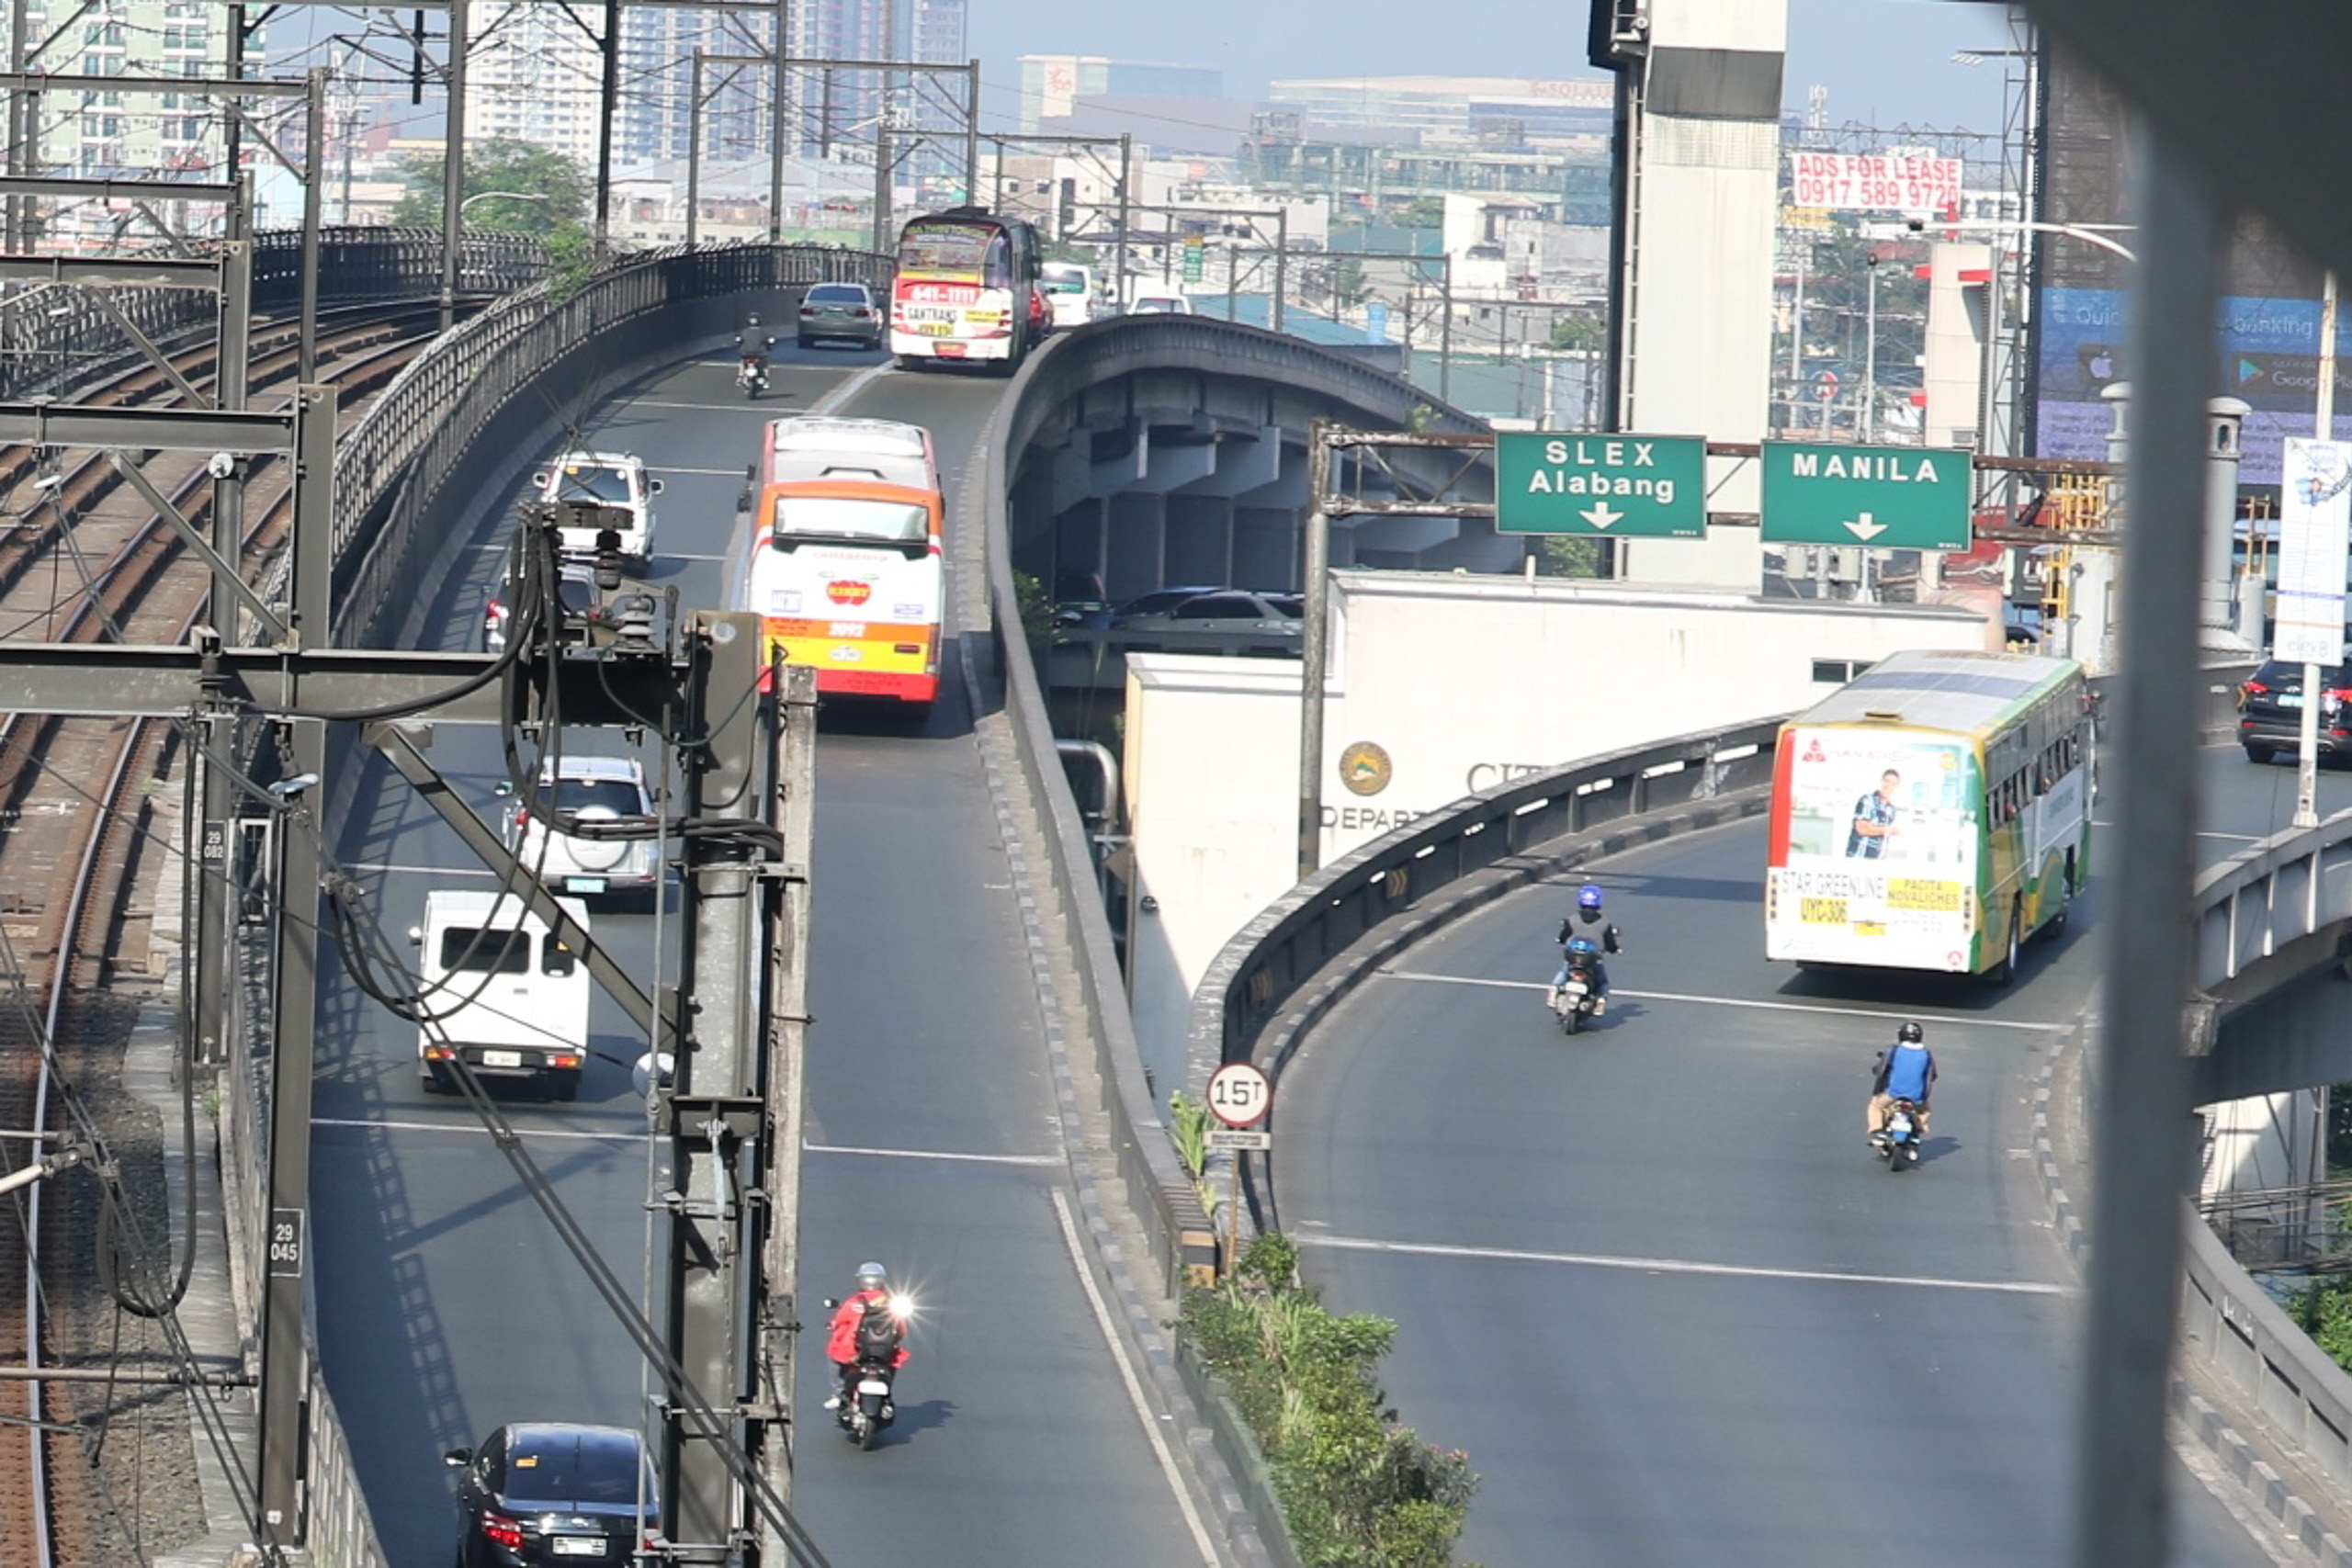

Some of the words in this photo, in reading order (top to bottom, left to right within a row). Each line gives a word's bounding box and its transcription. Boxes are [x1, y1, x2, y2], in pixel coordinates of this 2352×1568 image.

[1798, 154, 1838, 176] ADS
[1846, 158, 1886, 178] FOR
[1894, 159, 1958, 182] LEASE
[1800, 179, 1850, 203] 0917
[1861, 181, 1900, 205] 589
[1908, 184, 1958, 209] 9720
[2272, 370, 2316, 389] Goog
[1544, 440, 1655, 467] SLEX
[1792, 453, 1939, 482] MANILA
[1528, 469, 1675, 503] Alabang
[1321, 806, 1430, 830] DEPAR
[208, 830, 221, 844] 29
[1782, 872, 1812, 893] STAR
[1816, 873, 1883, 899] GREENLINE
[1905, 879, 1943, 891] PACITA
[1888, 890, 1960, 906] NOVALICHES
[275, 1223, 293, 1242] 29
[271, 1243, 297, 1261] 045
